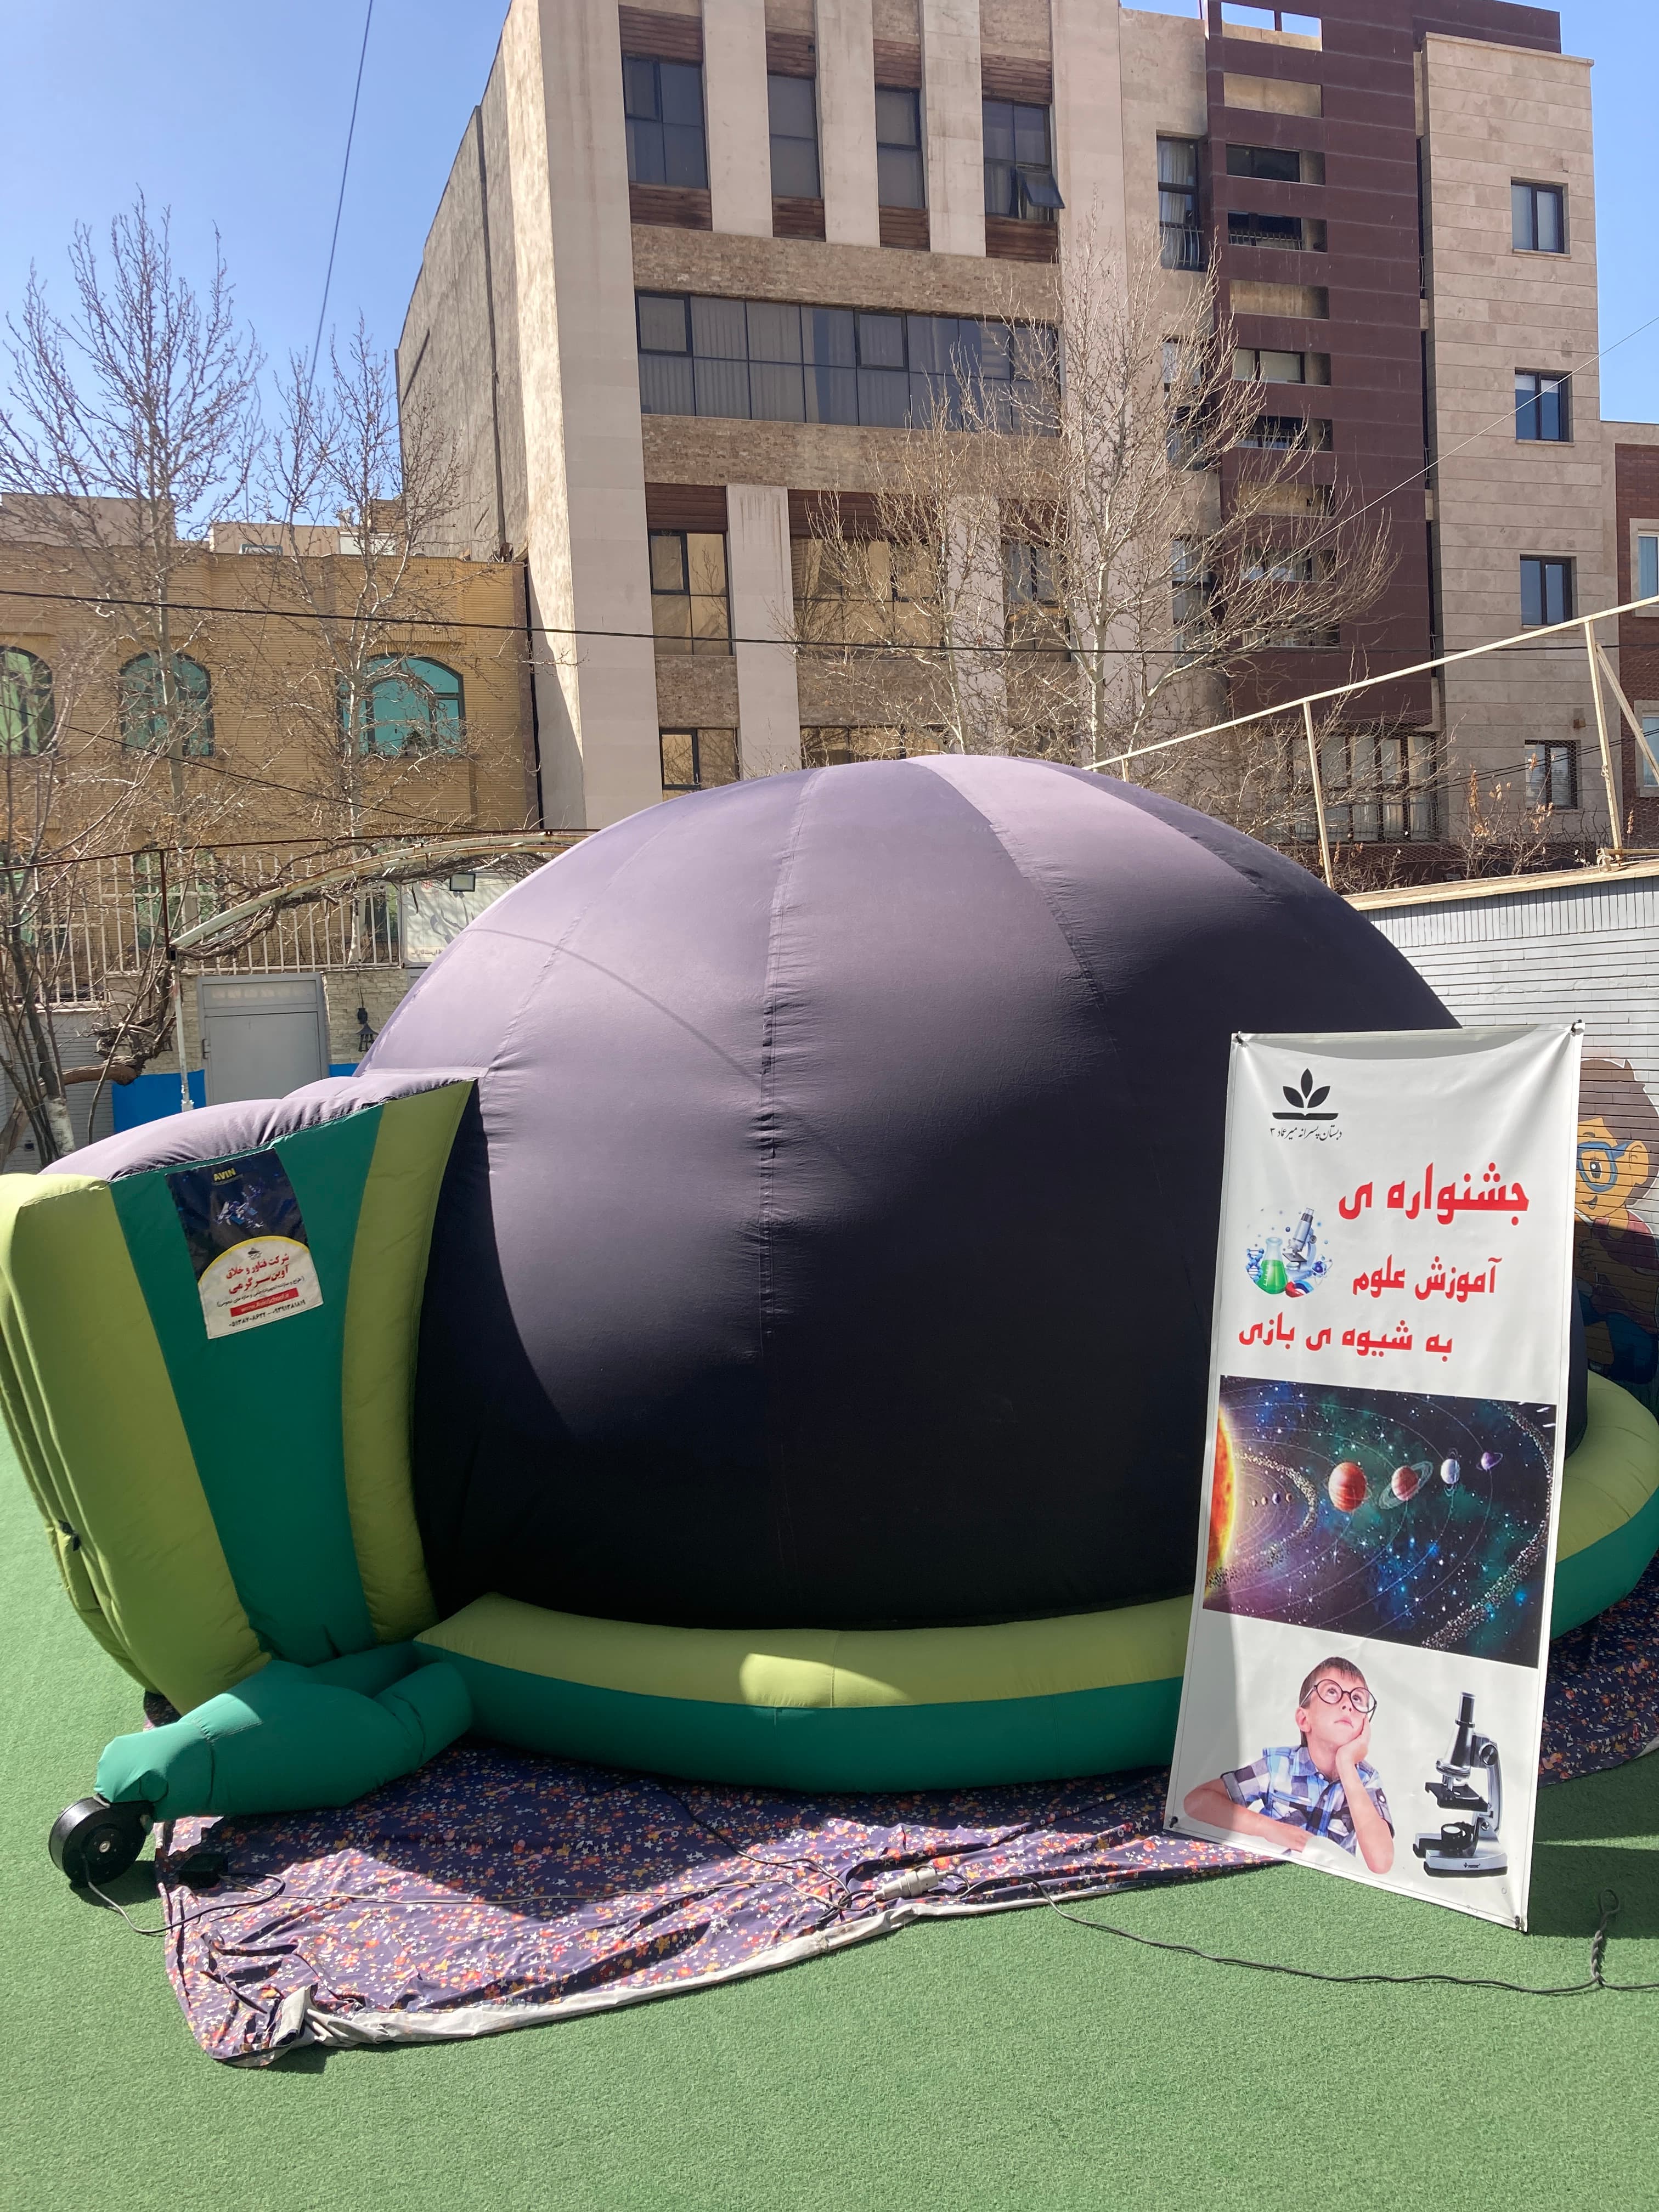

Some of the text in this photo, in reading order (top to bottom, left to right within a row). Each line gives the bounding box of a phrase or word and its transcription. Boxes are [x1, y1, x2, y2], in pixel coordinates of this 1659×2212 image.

[1270, 1127, 1276, 1137] ۳
[1298, 1125, 1319, 1139] پسرانه
[1319, 1125, 1342, 1141] دبستان
[213, 1167, 236, 1181] AVIN
[1338, 1161, 1530, 1226] جشنواره ی
[251, 1259, 267, 1273] فناور
[268, 1253, 289, 1265] شرکت
[226, 1265, 244, 1279] خلاق
[245, 1267, 250, 1275] و
[271, 1263, 290, 1282] آوین
[1352, 1255, 1502, 1304] آموزش علوم
[1238, 1312, 1453, 1363] به شیوه ی بازی
